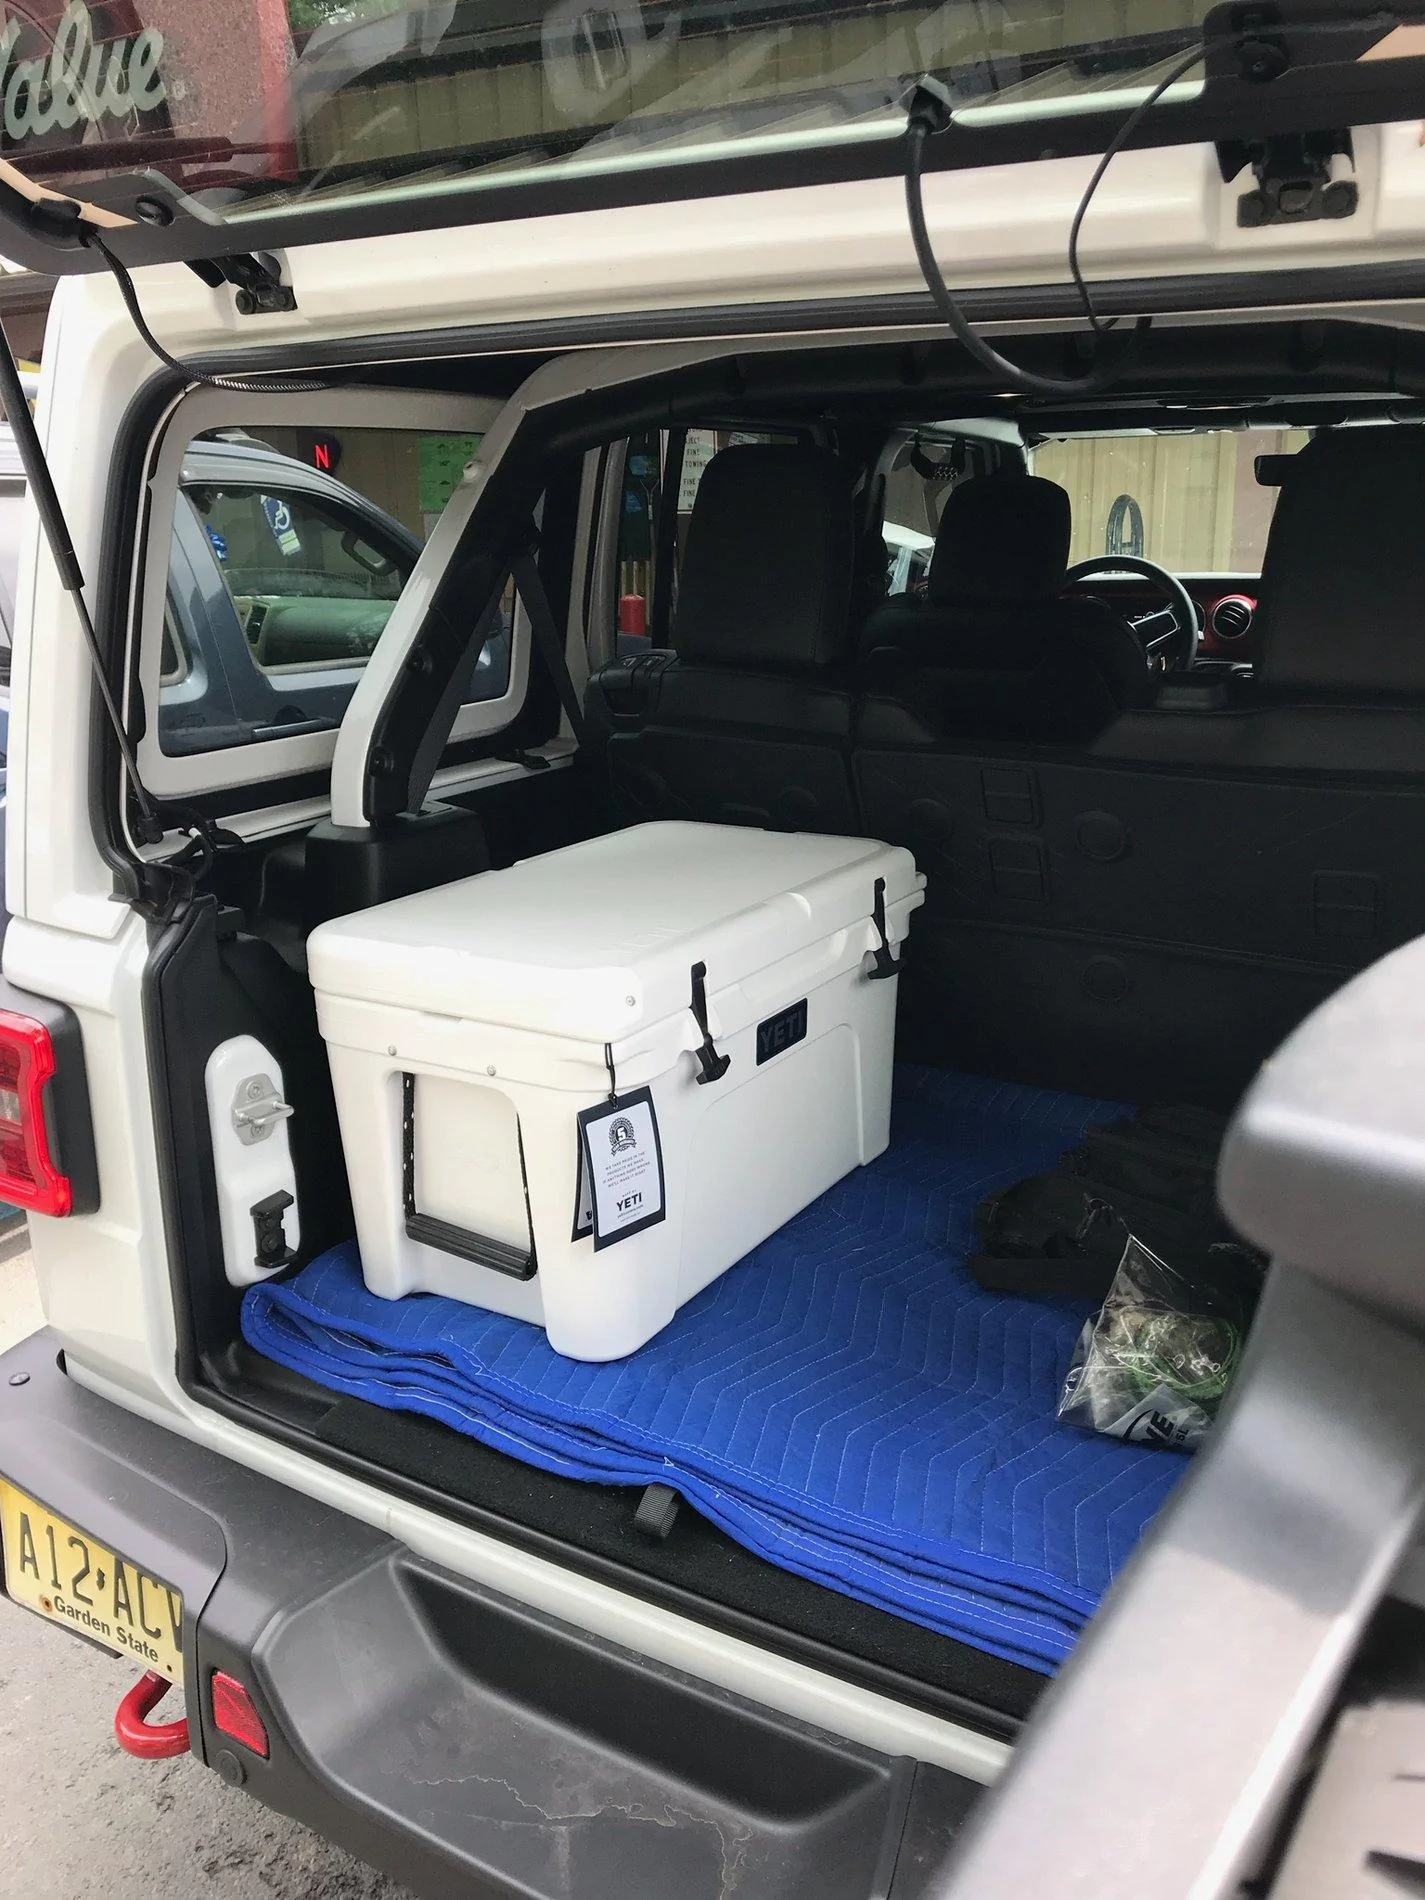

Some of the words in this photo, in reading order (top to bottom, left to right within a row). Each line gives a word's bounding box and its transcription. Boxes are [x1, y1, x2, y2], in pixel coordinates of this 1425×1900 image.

[314, 443, 330, 468] N
[760, 1010, 803, 1052] YETI
[616, 1192, 642, 1211] YETI
[20, 1512, 94, 1606] A12
[53, 1595, 111, 1637] Garden
[117, 1626, 159, 1662] State
